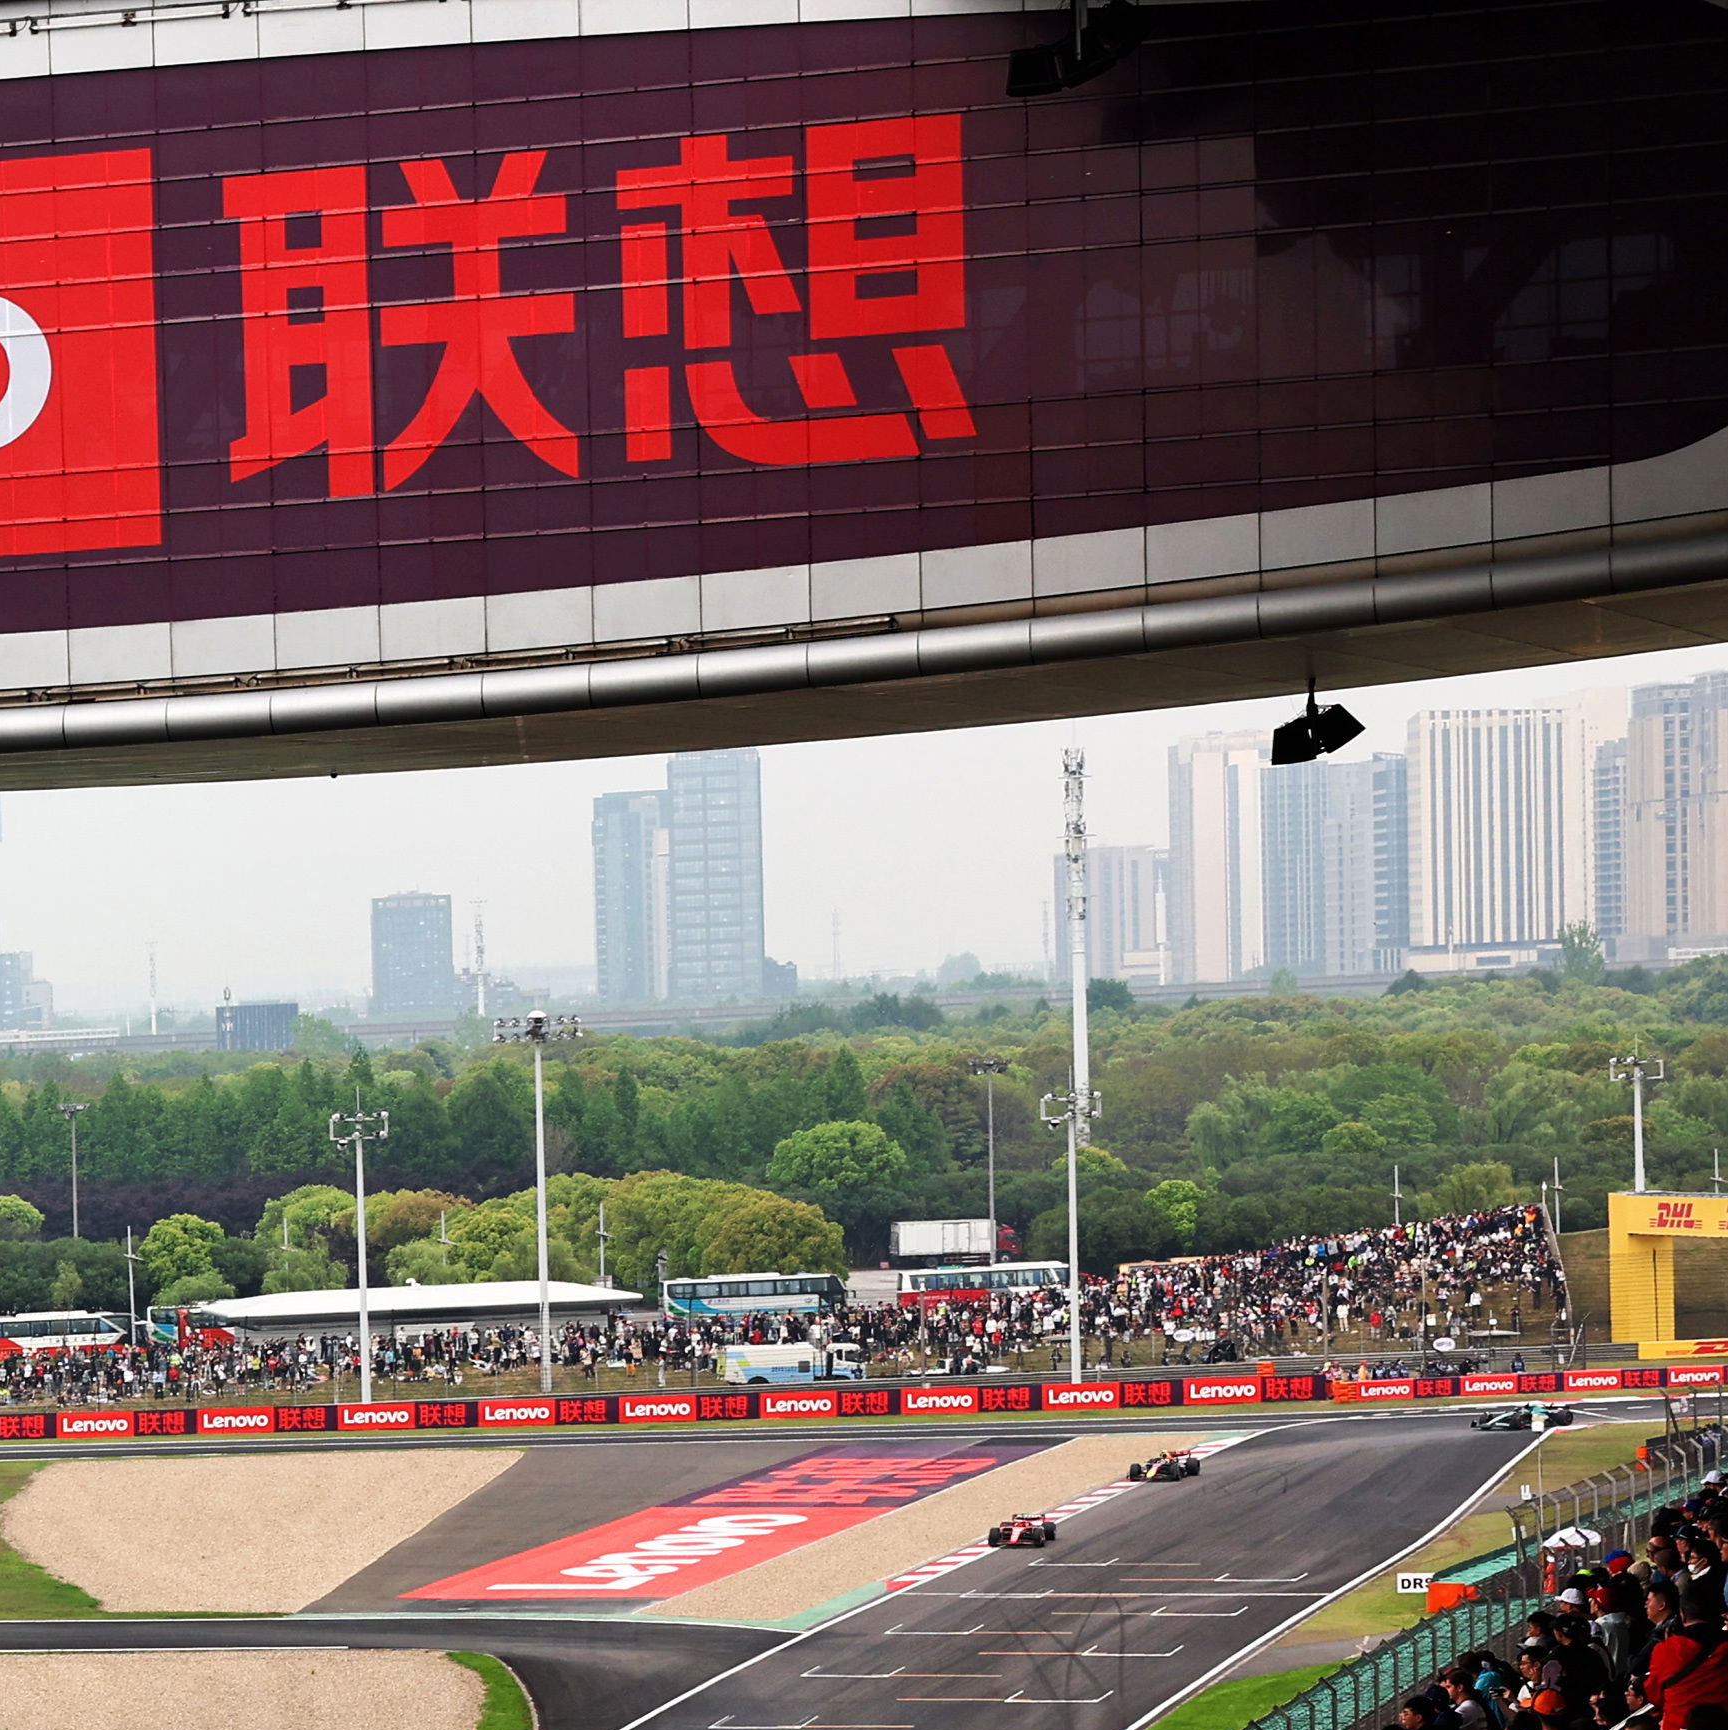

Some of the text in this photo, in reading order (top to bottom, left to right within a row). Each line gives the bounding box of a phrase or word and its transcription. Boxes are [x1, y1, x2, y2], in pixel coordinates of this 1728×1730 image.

[165, 115, 973, 500] 联想
[1656, 1202, 1696, 1229] DHL
[1568, 1374, 1618, 1388] Lenovo
[1671, 1370, 1720, 1384] Lenovo
[1124, 1383, 1171, 1406] 联想
[1190, 1383, 1256, 1399] Lenovo
[1266, 1376, 1313, 1400] 联想
[1361, 1383, 1410, 1398] Lenovo
[1465, 1379, 1514, 1393] Lenovo
[766, 1396, 832, 1413] Lenovo
[842, 1391, 889, 1415] 联想
[907, 1392, 973, 1409] Lenovo
[982, 1387, 1030, 1411] 联想
[1048, 1389, 1114, 1405] Lenovo
[419, 1403, 466, 1427] 联想
[484, 1405, 550, 1421] Lenovo
[560, 1400, 607, 1423] 联想
[625, 1400, 690, 1417] Lenovo
[700, 1396, 747, 1419] 联想
[62, 1417, 128, 1433] Lenovo
[138, 1411, 184, 1435] 联想
[203, 1414, 269, 1430] Lenovo
[278, 1407, 325, 1431] 联想
[343, 1409, 410, 1425] Lenovo
[487, 1513, 808, 1591] Lenovo
